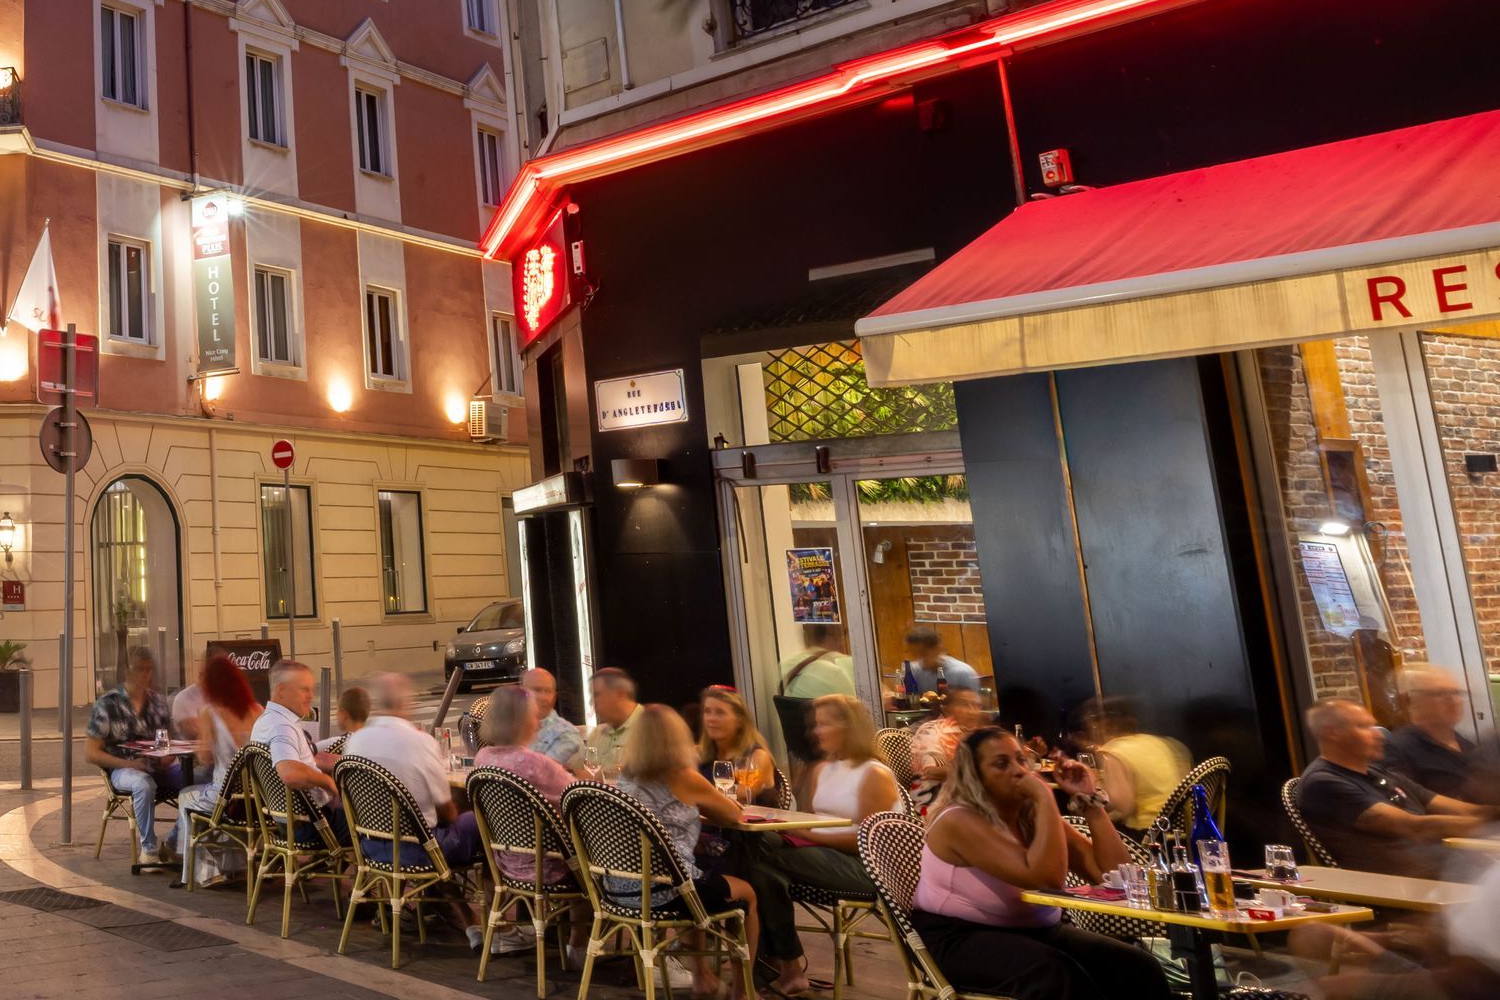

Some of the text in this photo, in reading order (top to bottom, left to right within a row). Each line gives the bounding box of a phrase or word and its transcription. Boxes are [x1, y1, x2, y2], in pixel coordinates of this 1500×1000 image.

[1366, 262, 1500, 322] RE
[207, 266, 221, 342] HOTEL
[627, 389, 642, 399] RUE
[12, 585, 20, 594] H
[227, 650, 271, 671] Coca-Cola
